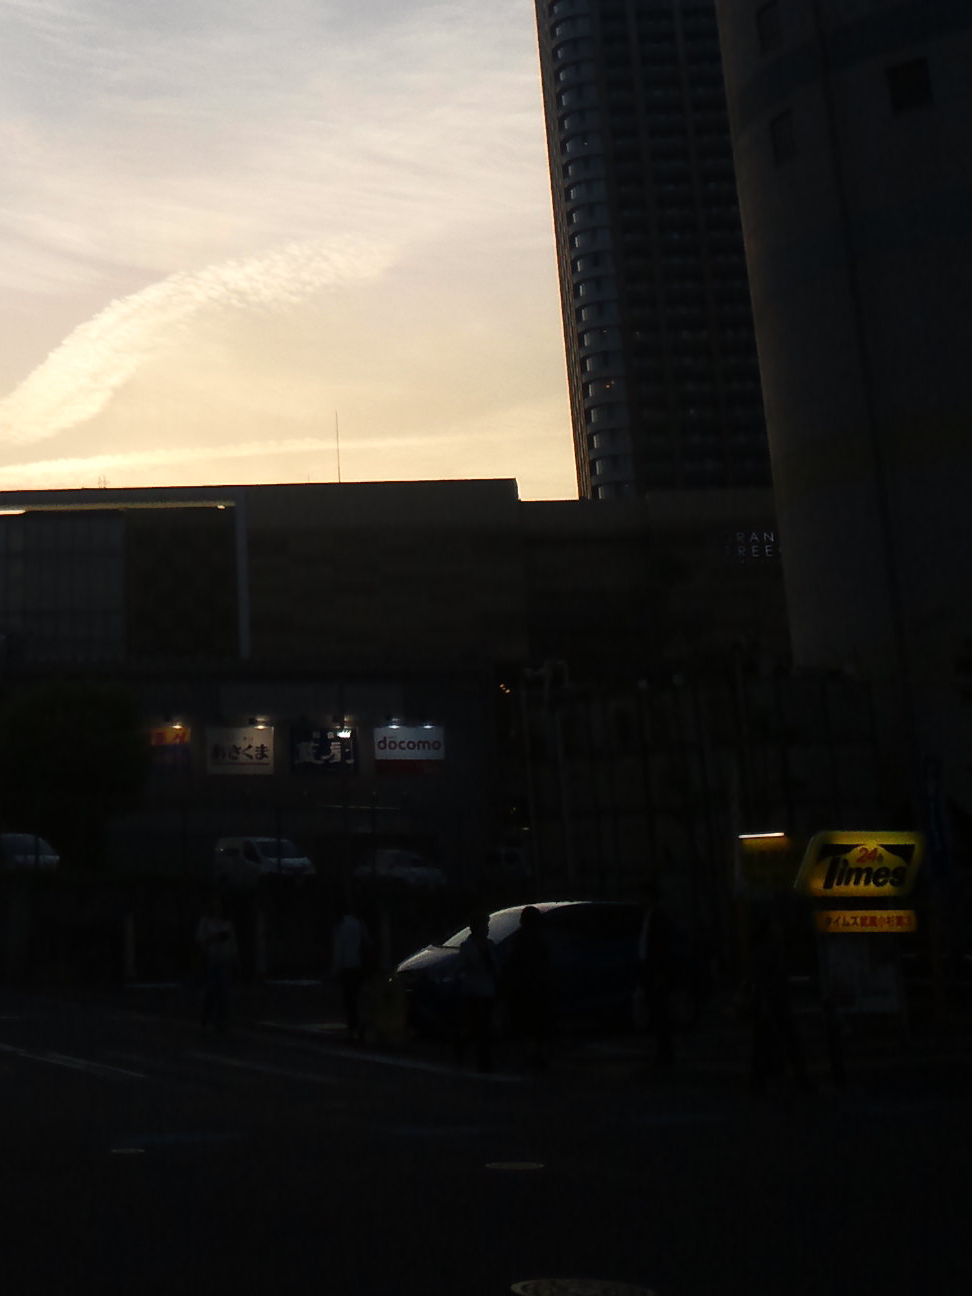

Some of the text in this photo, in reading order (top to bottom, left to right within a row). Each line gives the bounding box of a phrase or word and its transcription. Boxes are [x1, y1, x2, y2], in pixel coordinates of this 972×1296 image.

[378, 736, 441, 751] docomo
[212, 744, 269, 760] あさくま
[823, 856, 908, 890] Times
